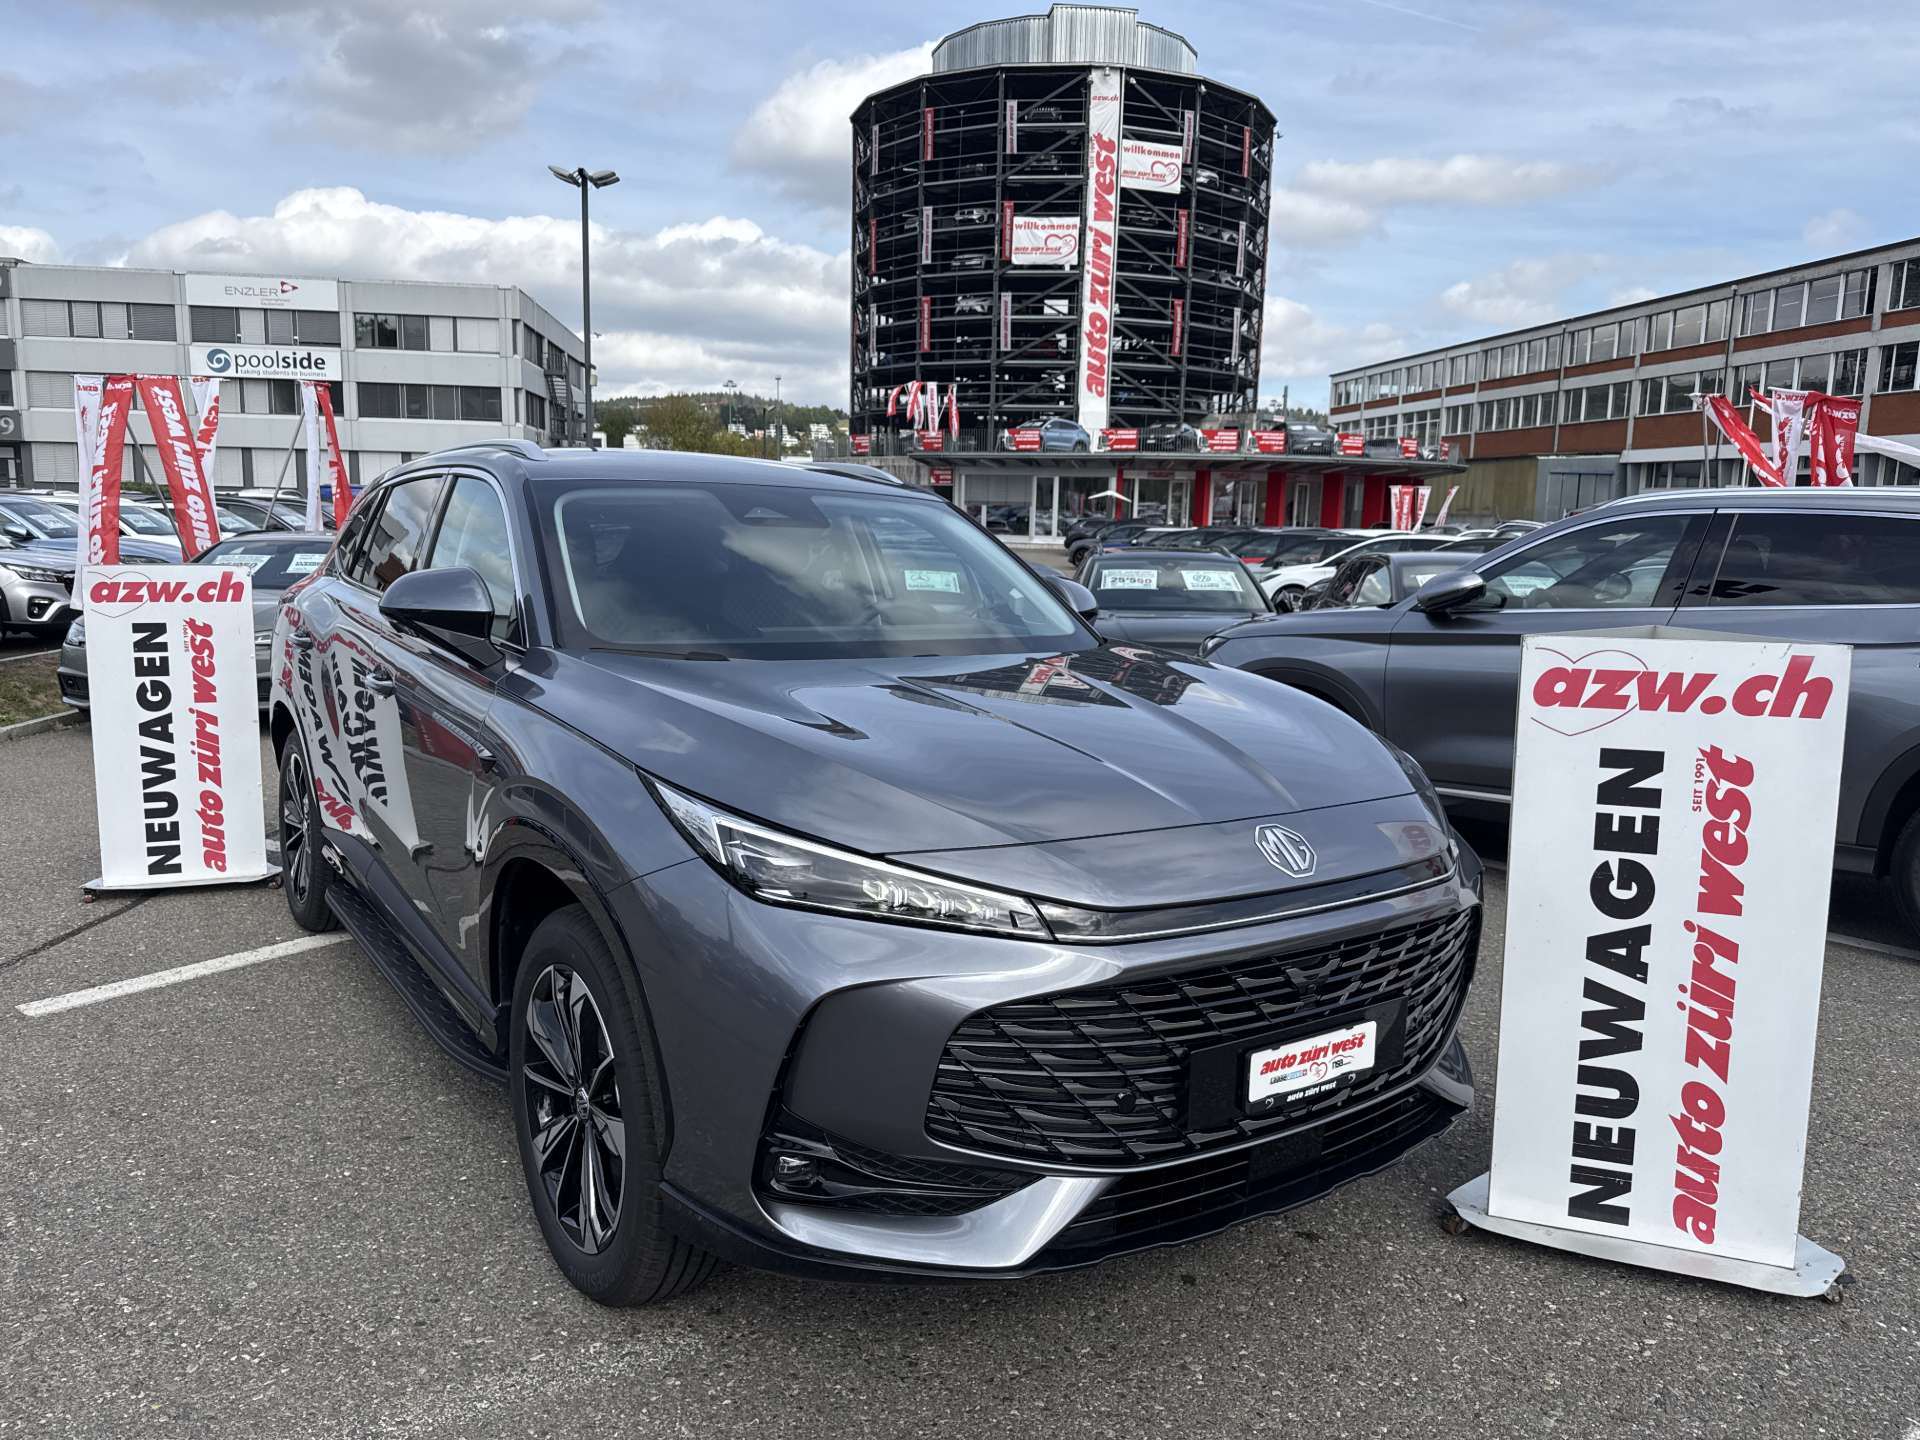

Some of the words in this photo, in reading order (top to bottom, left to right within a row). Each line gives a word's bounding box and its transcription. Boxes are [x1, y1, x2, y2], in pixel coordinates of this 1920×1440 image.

[1092, 132, 1117, 222] west
[1123, 145, 1181, 159] willkommen
[1015, 222, 1078, 230] willkommen
[225, 285, 279, 297] ENZLER
[1086, 226, 1113, 310] züri
[234, 350, 326, 374] poolside
[240, 369, 261, 377] taking
[262, 369, 290, 377] students
[1083, 311, 1109, 398] auto
[150, 386, 185, 437] west
[167, 438, 202, 493] züri
[89, 571, 245, 603] azw.ch
[184, 617, 217, 704] west
[1532, 654, 1834, 720] azw.ch
[131, 622, 183, 876] NEUWAGEN
[188, 707, 223, 788] züri
[1693, 756, 1706, 784] 1991
[1691, 786, 1702, 812] SEIT
[195, 789, 228, 873] auto
[1261, 828, 1311, 872] MG
[1695, 744, 1755, 917] west
[1567, 747, 1666, 1227] NEUWAGEN
[1675, 919, 1740, 1085] züri
[1260, 1052, 1297, 1076] auto
[1297, 1040, 1332, 1066] züri
[1331, 1032, 1366, 1056] west
[1286, 1091, 1304, 1102] auto
[1668, 1080, 1726, 1245] auto
